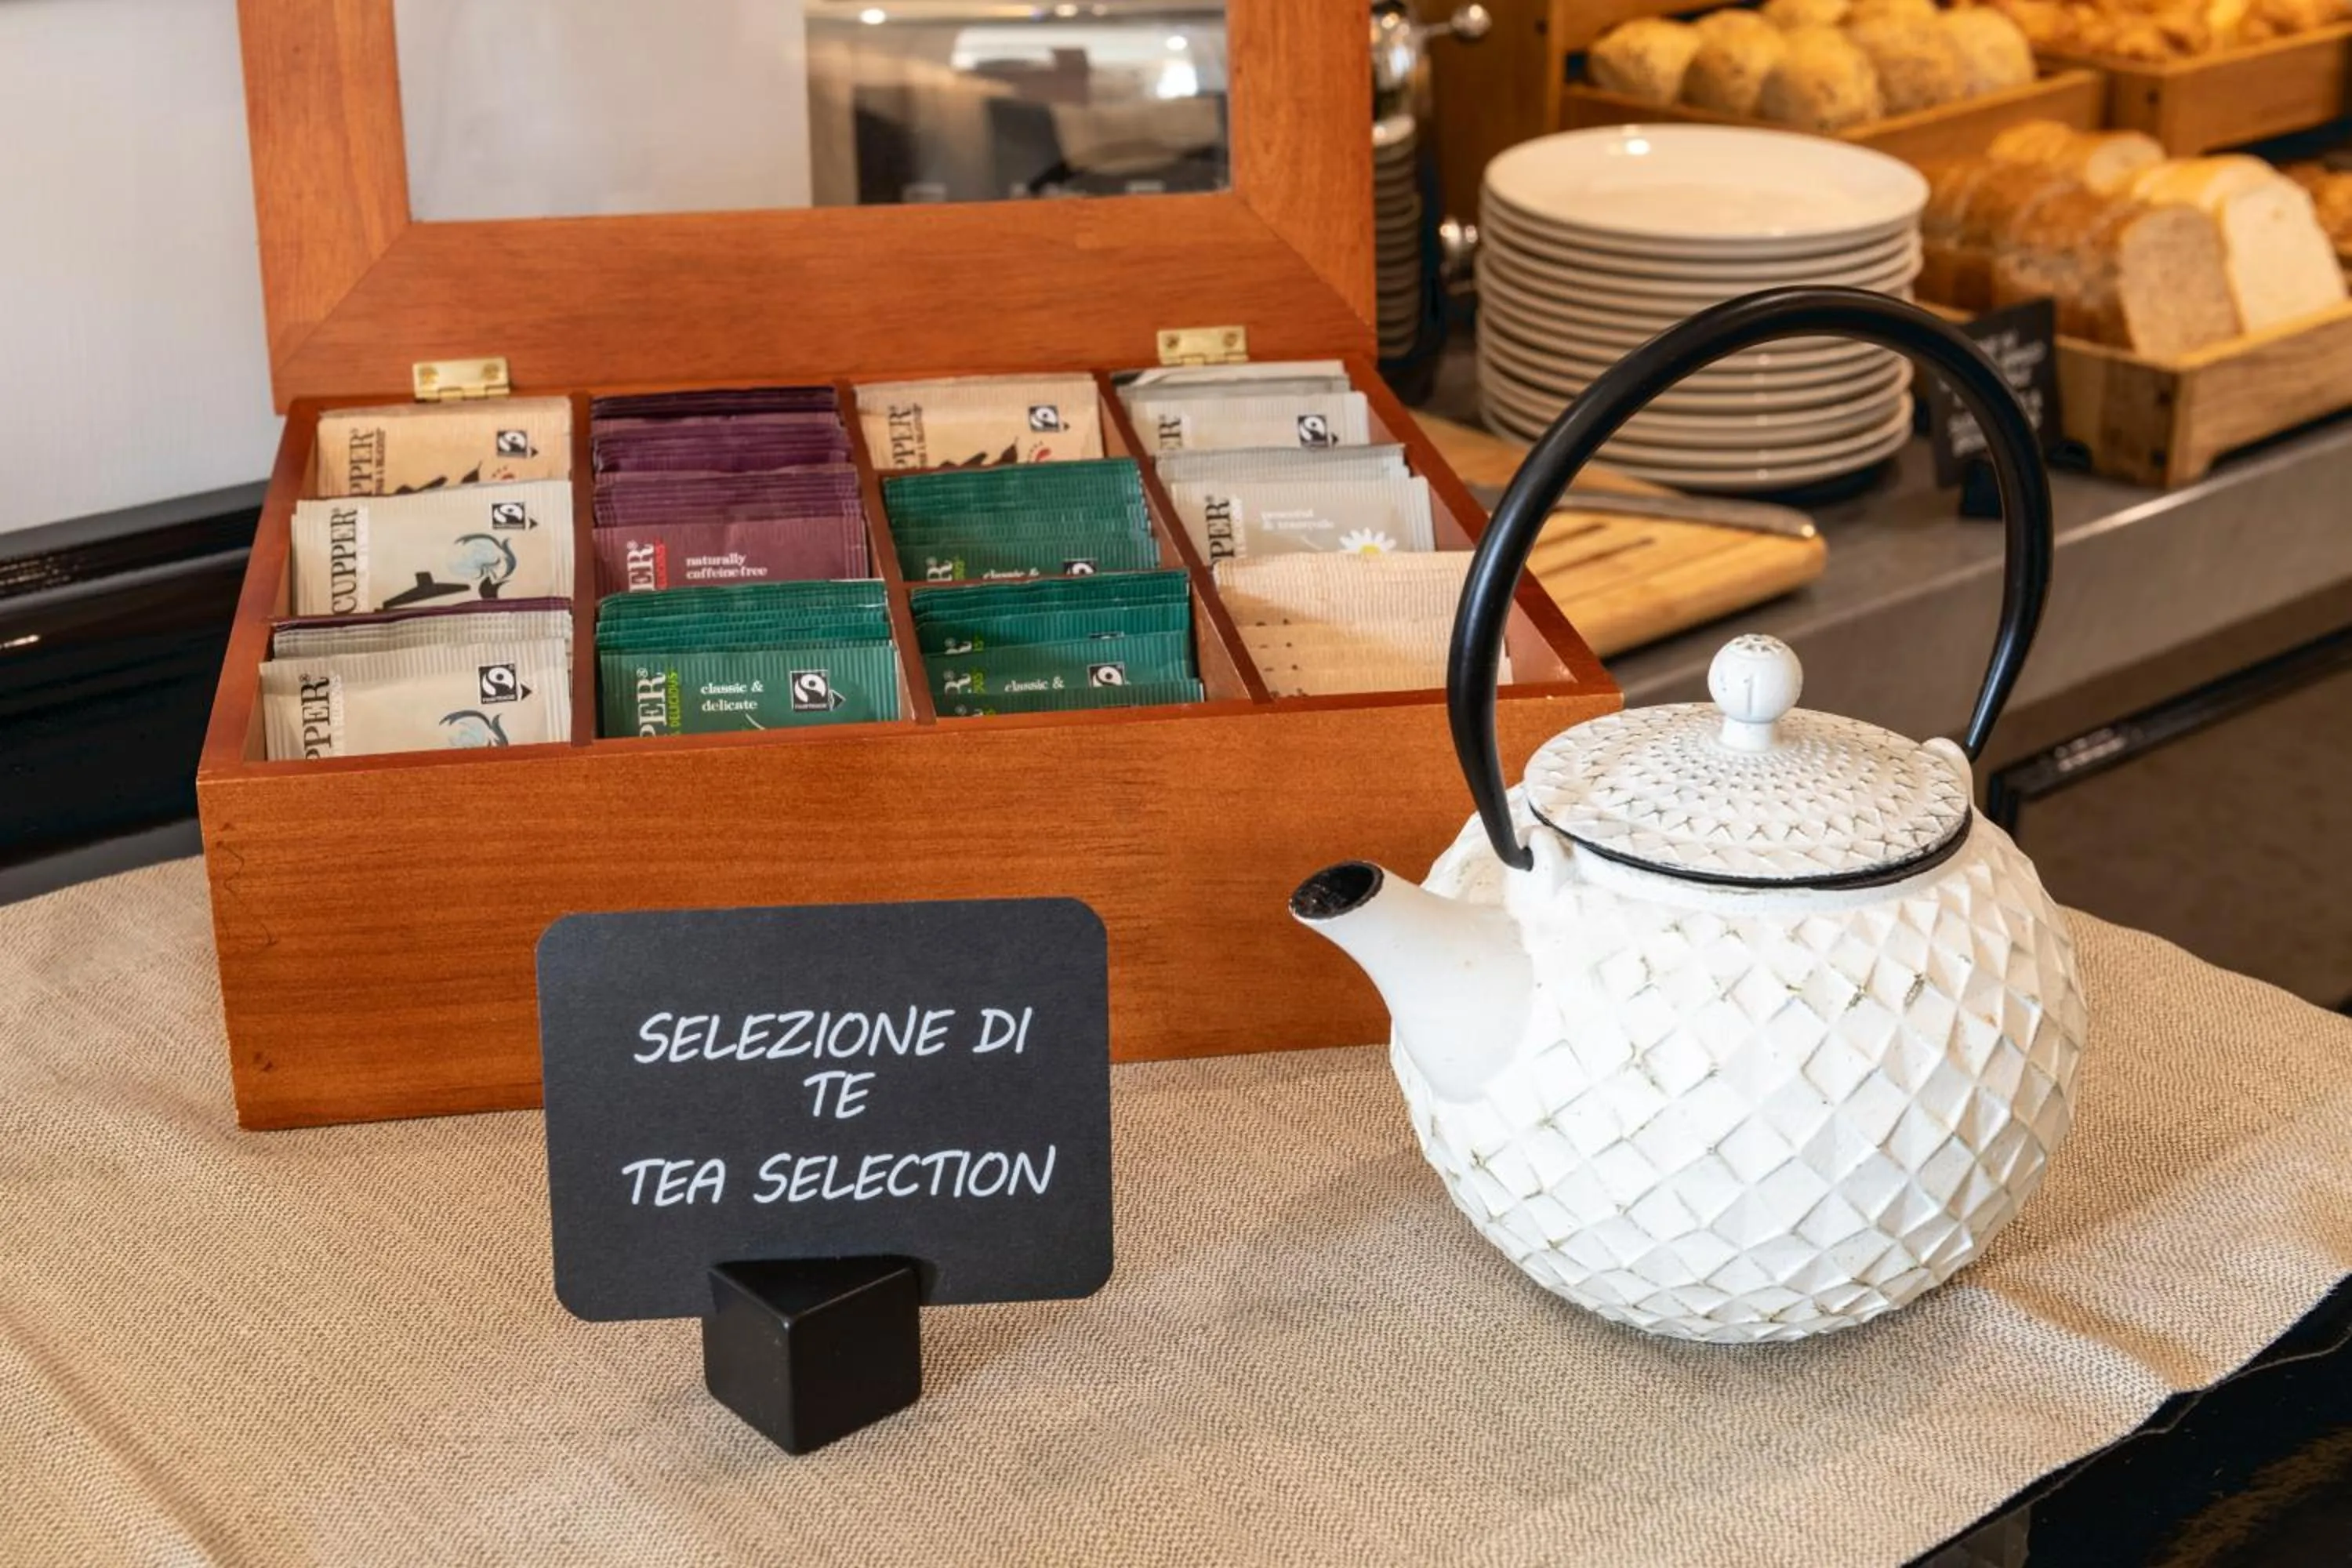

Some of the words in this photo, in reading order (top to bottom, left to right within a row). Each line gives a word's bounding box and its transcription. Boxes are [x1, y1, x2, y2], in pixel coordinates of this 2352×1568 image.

[350, 431, 375, 496] PPER
[686, 553, 747, 567] naturally
[700, 682, 747, 695] classic
[750, 680, 764, 693] &
[1004, 679, 1048, 692] classic
[1052, 676, 1065, 690] &
[702, 699, 758, 711] delicate
[633, 1005, 955, 1064] SELEZIONE
[972, 1007, 1033, 1054] DI
[803, 1070, 876, 1120] TE
[621, 1158, 727, 1207] TEA
[753, 1145, 1056, 1203] SELECTION
